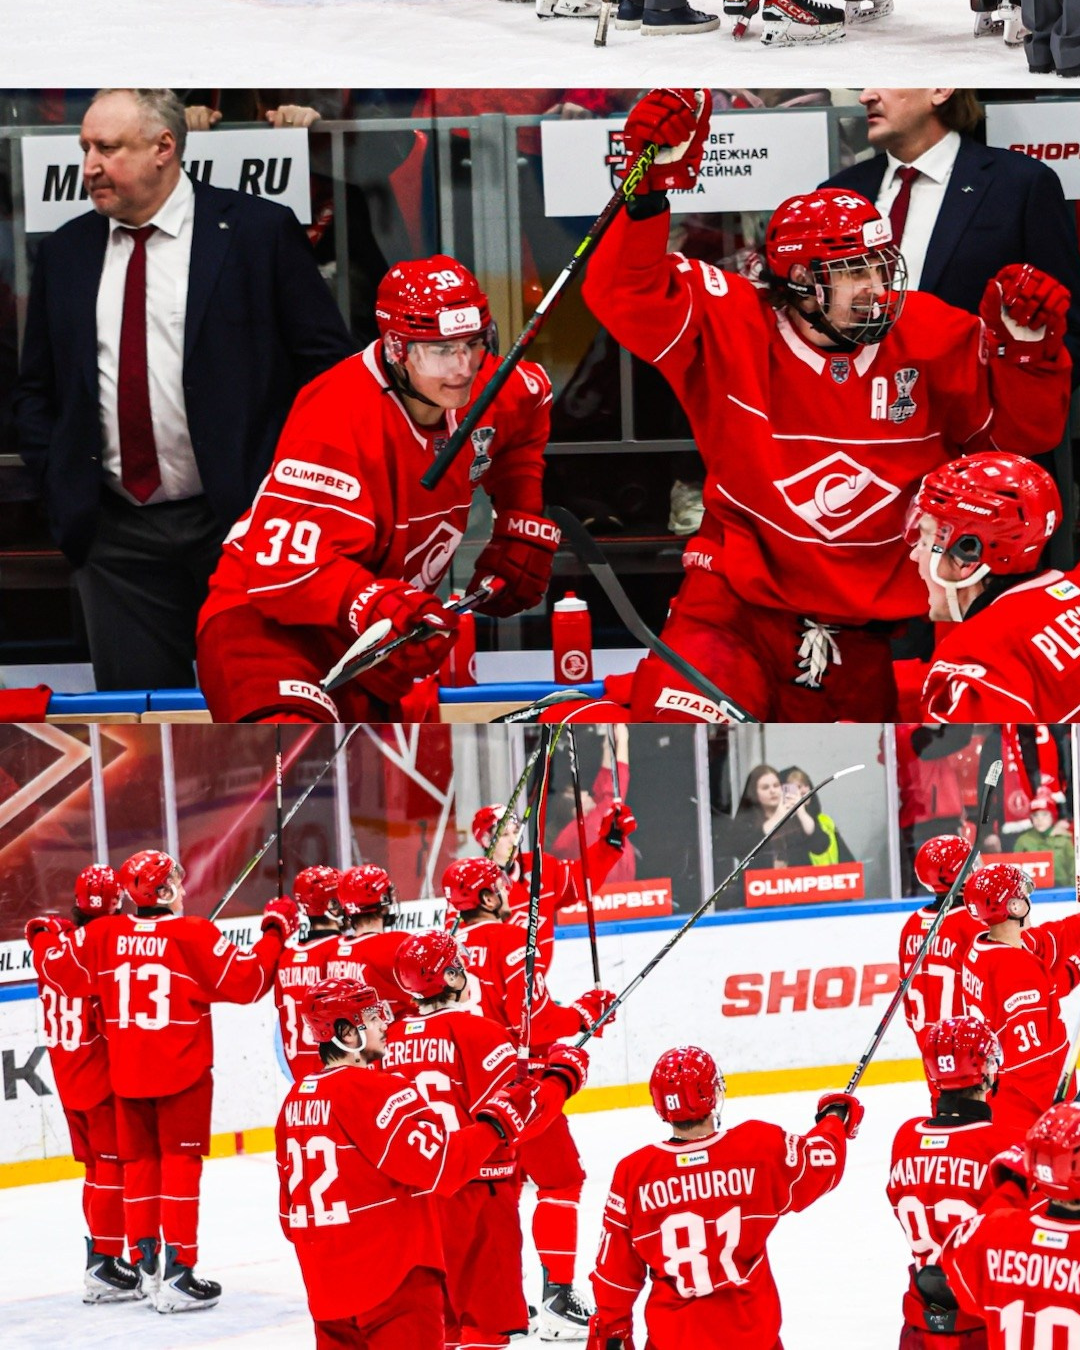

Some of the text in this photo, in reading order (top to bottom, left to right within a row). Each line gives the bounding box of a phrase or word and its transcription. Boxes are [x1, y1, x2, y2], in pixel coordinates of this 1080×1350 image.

[777, 243, 802, 252] CCM
[428, 269, 462, 291] 39
[281, 465, 354, 493] OLIMPBET
[255, 517, 322, 566] 39
[749, 873, 860, 898] OLIMPBET
[117, 935, 168, 958] BYKOV
[114, 961, 171, 1031] 13
[1013, 1020, 1042, 1053] 39
[938, 1055, 956, 1073] 93
[285, 1100, 330, 1127] MALKOV
[379, 1091, 414, 1126] OLIMPBET
[665, 1093, 680, 1111] 81
[286, 1135, 351, 1229] 22
[890, 1155, 989, 1191] MATVEYEV
[1037, 1164, 1053, 1182] 19
[638, 1167, 756, 1213] KOCHUROV
[660, 1206, 750, 1299] 81
